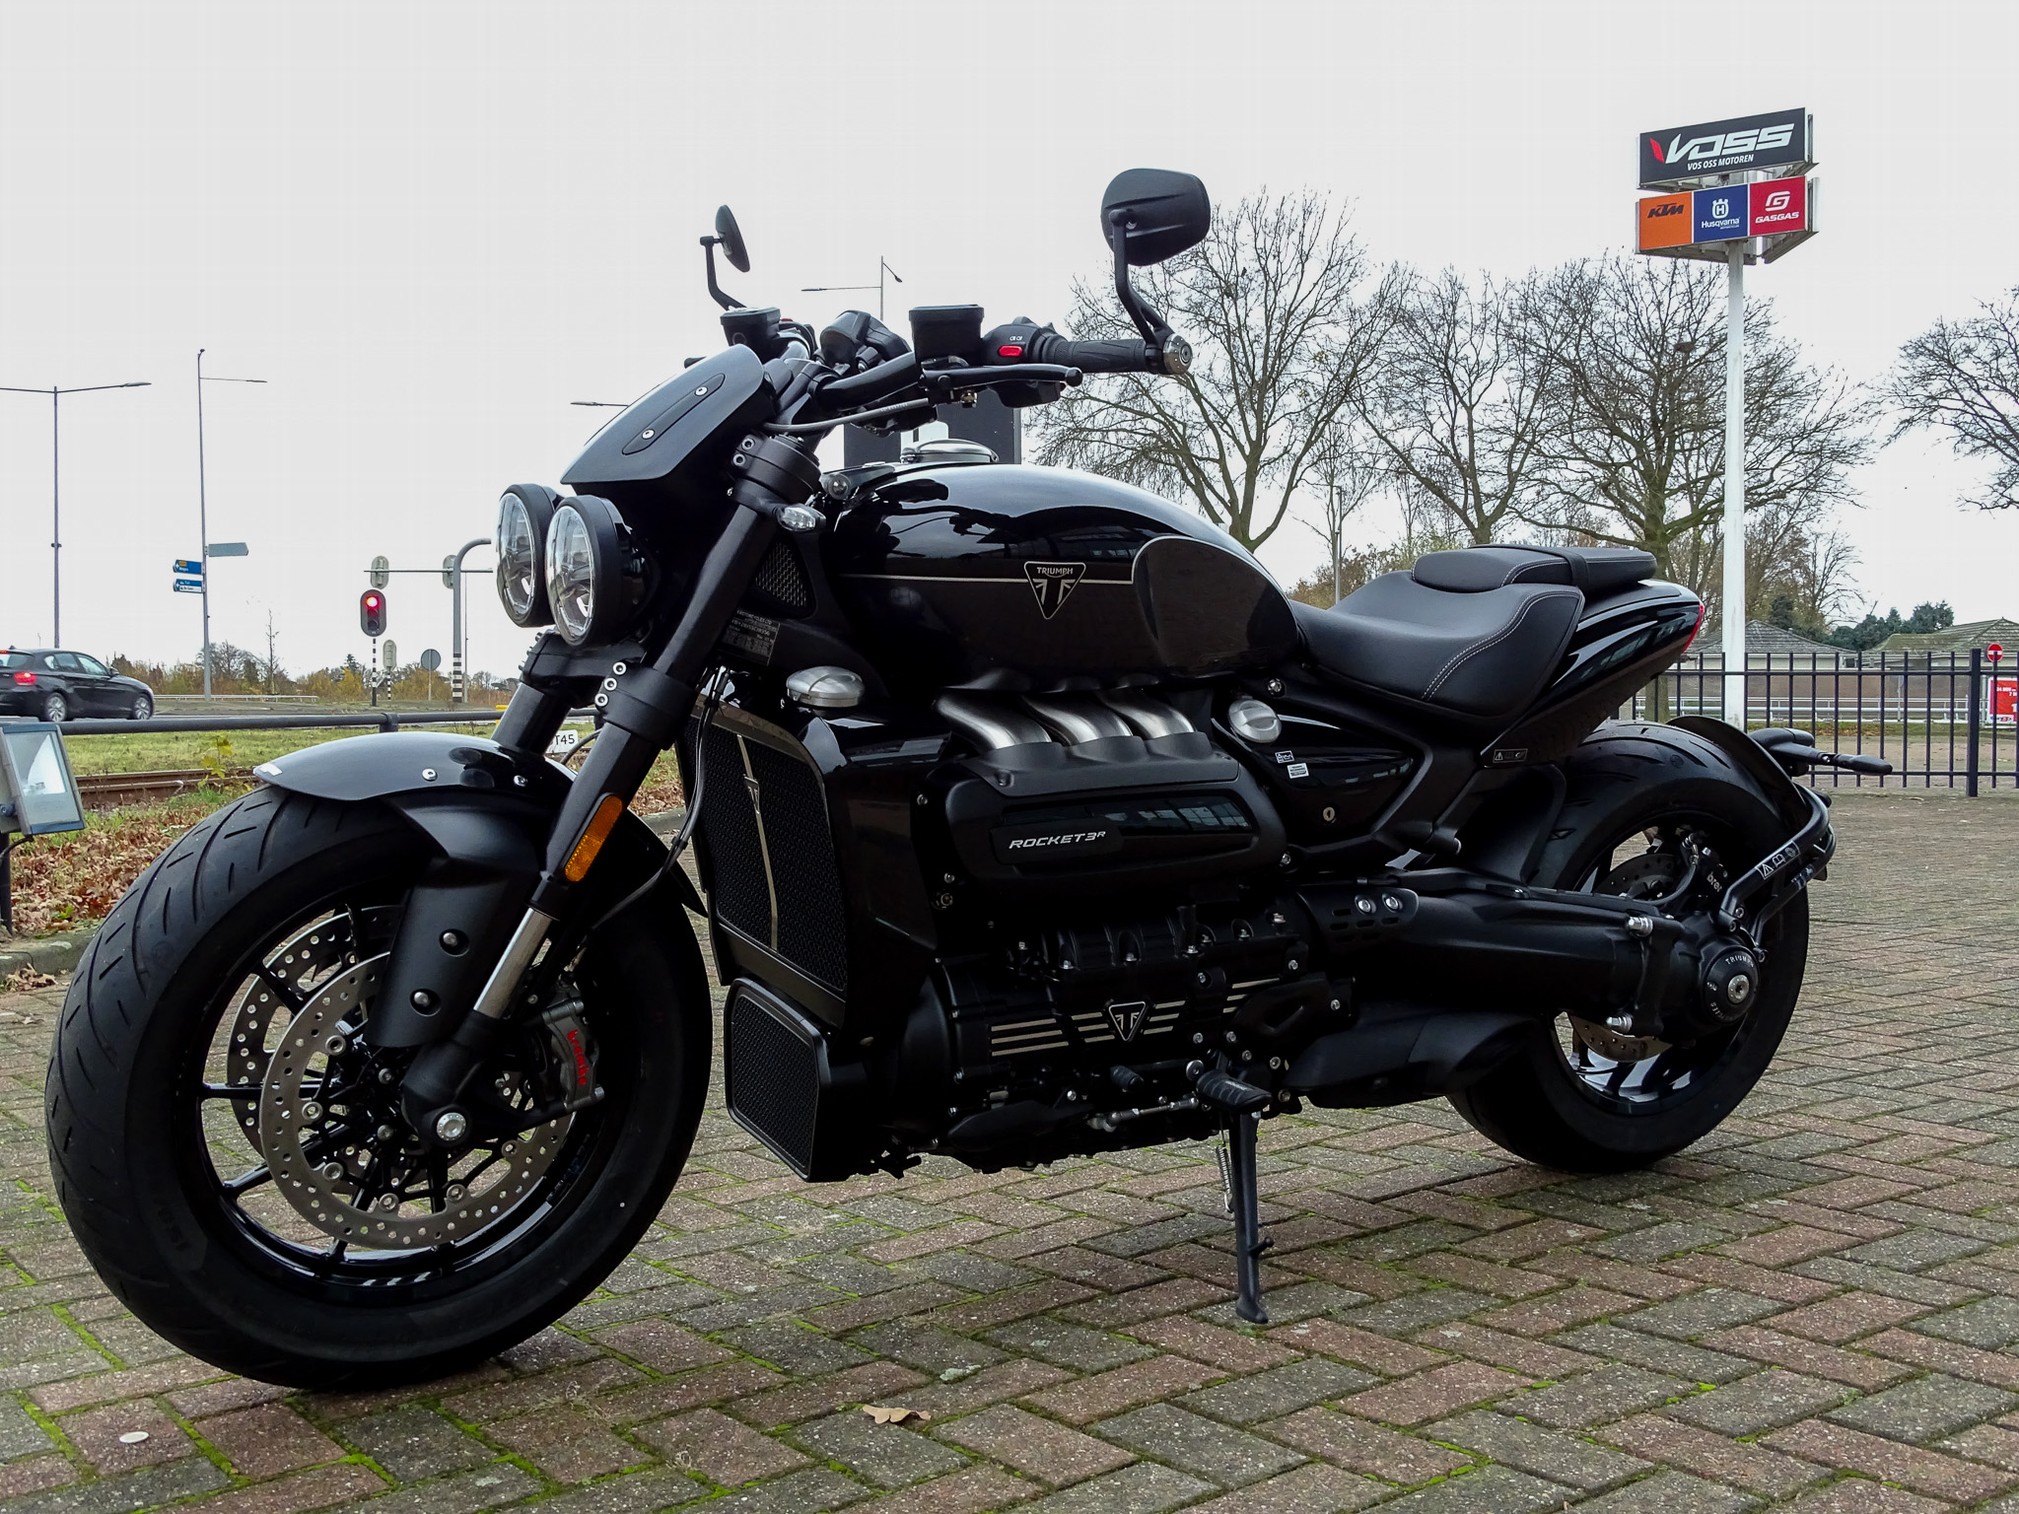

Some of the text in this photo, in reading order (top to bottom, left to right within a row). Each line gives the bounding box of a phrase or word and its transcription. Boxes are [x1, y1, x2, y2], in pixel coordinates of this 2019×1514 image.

[1650, 123, 1794, 164] VOSS
[1687, 154, 1754, 171] VOS OSS MOTOREN
[1647, 203, 1684, 218] KTM
[1701, 217, 1740, 229] Husqvarna
[1755, 212, 1799, 224] GASGAS
[1037, 567, 1073, 578] TRIUMPH
